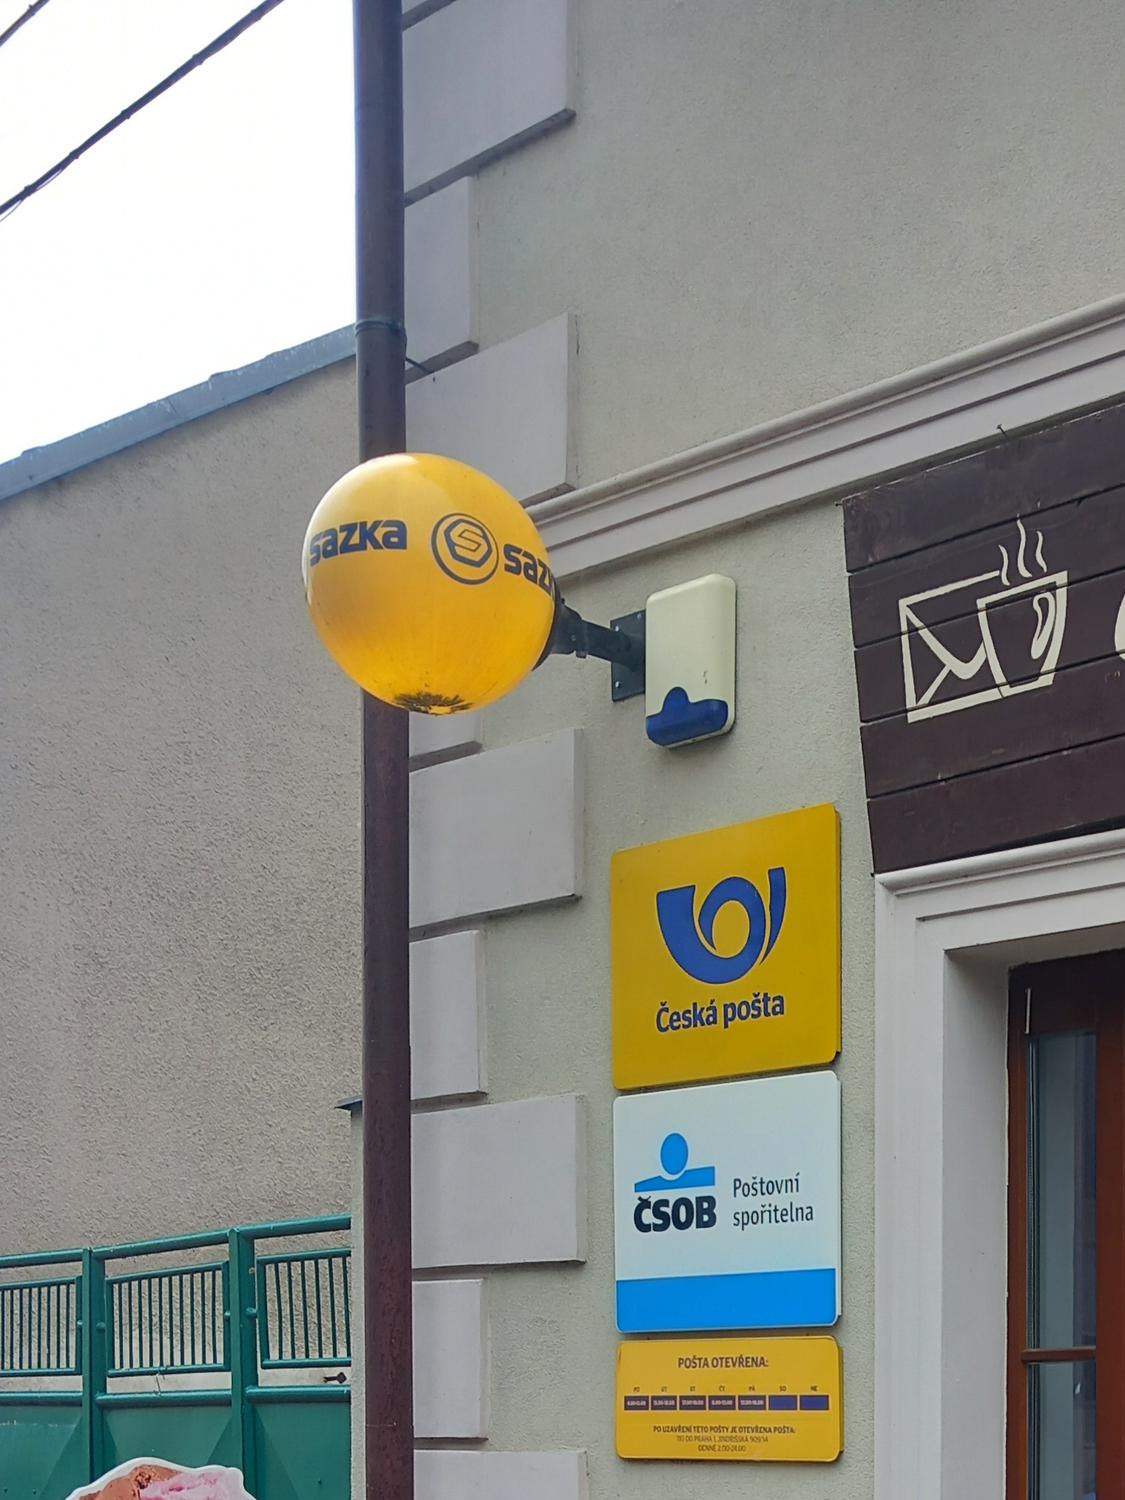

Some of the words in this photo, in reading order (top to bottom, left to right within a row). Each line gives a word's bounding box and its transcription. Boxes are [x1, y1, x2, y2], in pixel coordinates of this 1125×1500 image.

[656, 999, 718, 1033] Česká
[723, 992, 785, 1028] pošta
[733, 1172, 800, 1198] Poštovní
[633, 1195, 718, 1233] ČSOB
[733, 1201, 814, 1231] spořitelna
[678, 1355, 710, 1369] POŠTA
